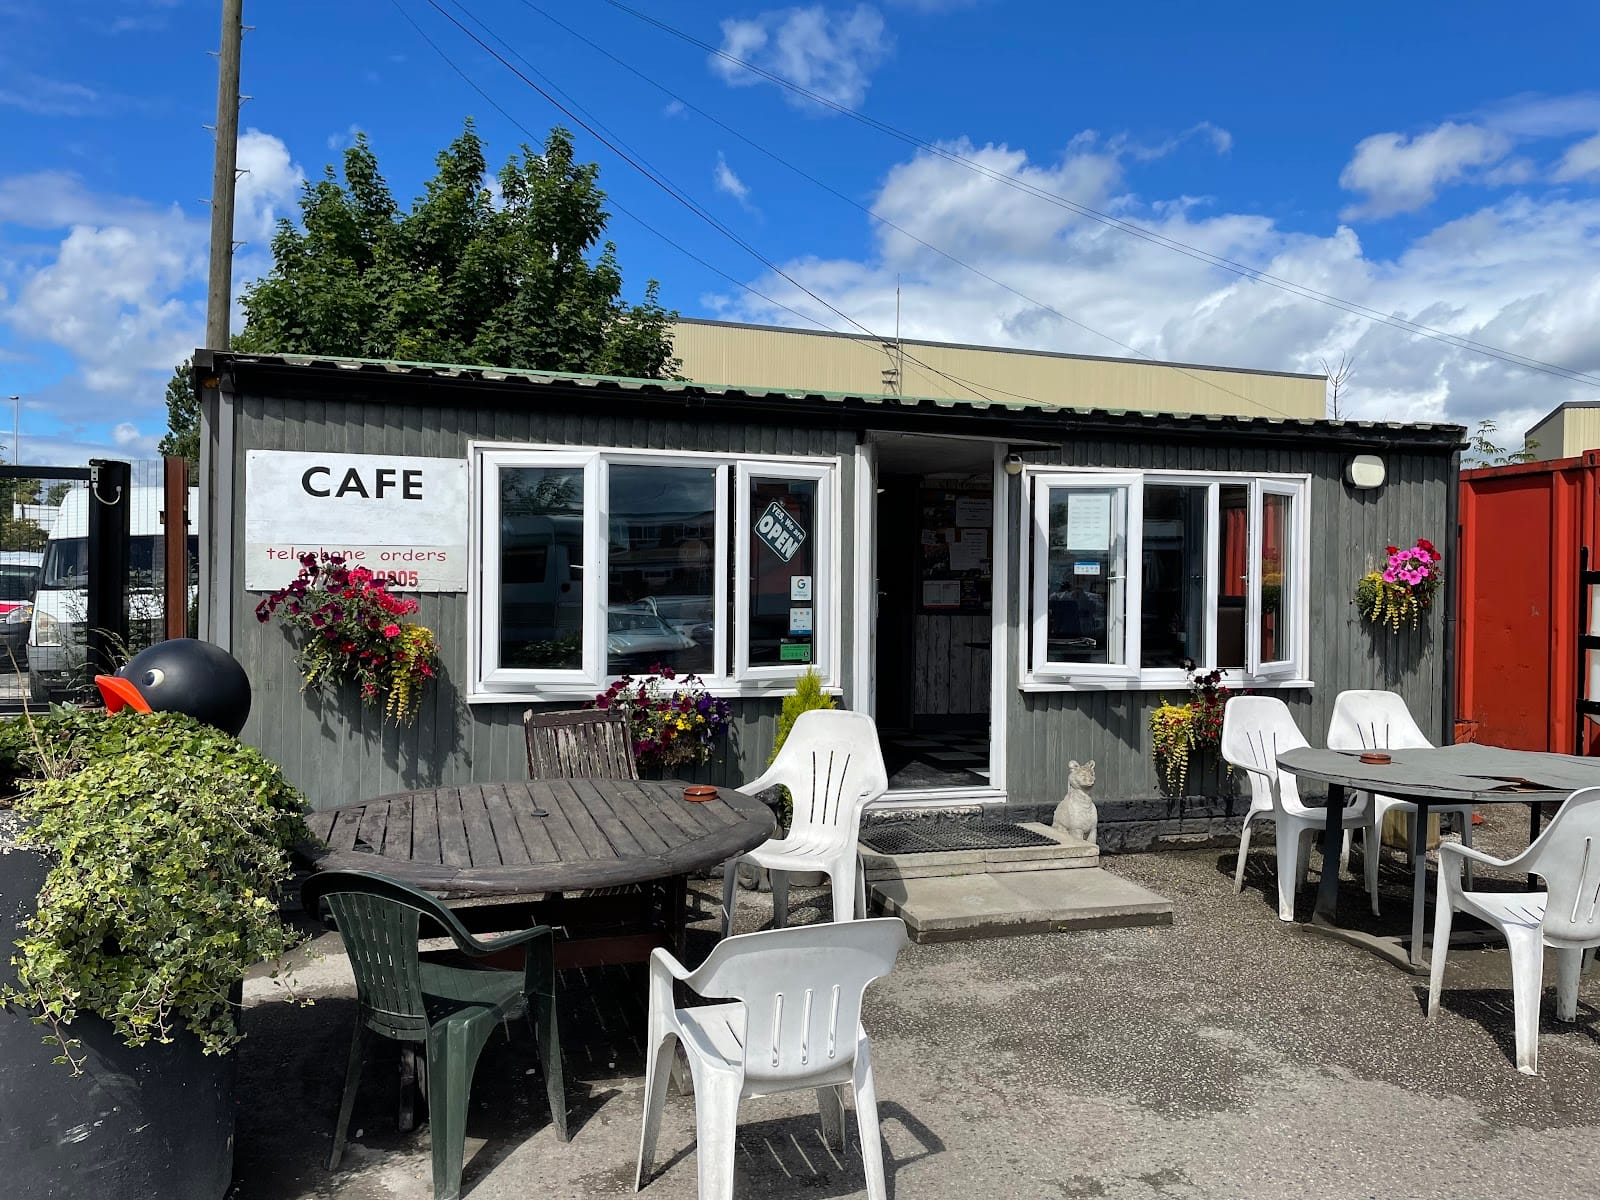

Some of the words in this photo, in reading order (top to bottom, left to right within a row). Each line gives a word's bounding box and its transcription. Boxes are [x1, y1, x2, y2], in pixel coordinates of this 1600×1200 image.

[301, 466, 423, 500] CAFE
[759, 515, 798, 558] OPEN
[785, 518, 795, 531] We
[793, 529, 804, 540] are
[380, 548, 447, 562] orders
[797, 578, 806, 589] G
